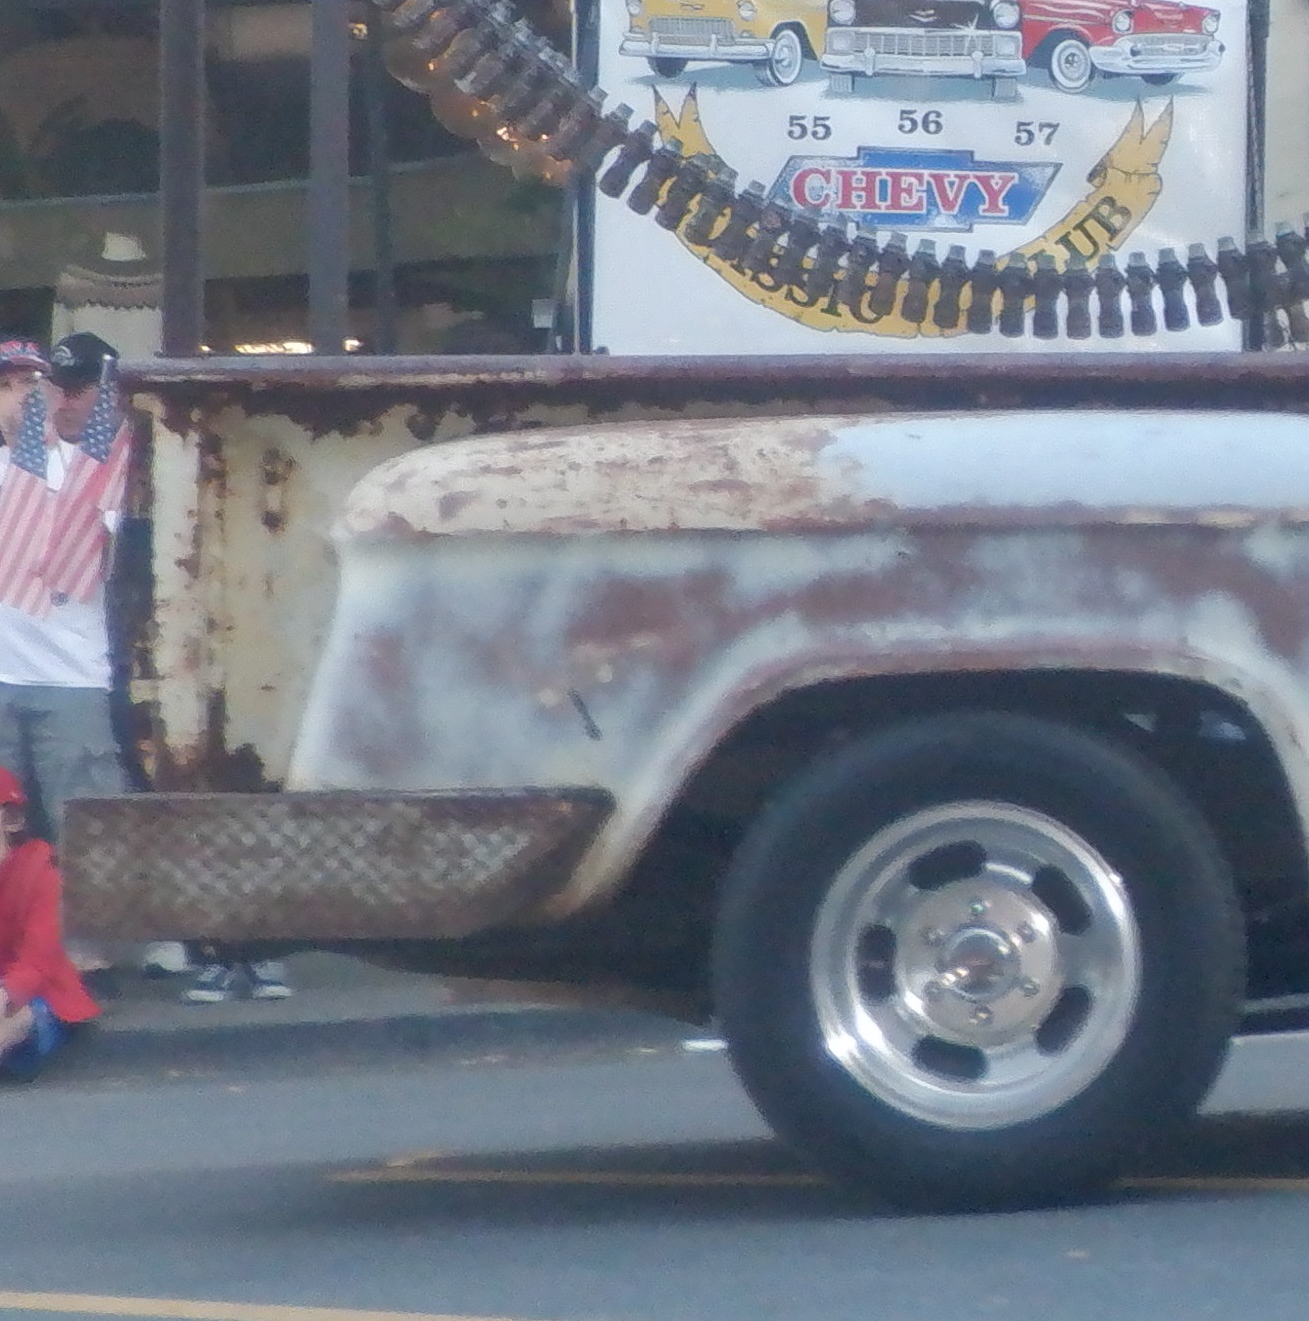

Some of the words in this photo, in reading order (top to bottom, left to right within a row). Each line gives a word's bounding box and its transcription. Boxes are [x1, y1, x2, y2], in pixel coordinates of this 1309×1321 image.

[786, 114, 833, 141] 55
[897, 108, 944, 136] 56
[1013, 120, 1061, 147] 57
[791, 166, 1019, 216] CHEVY
